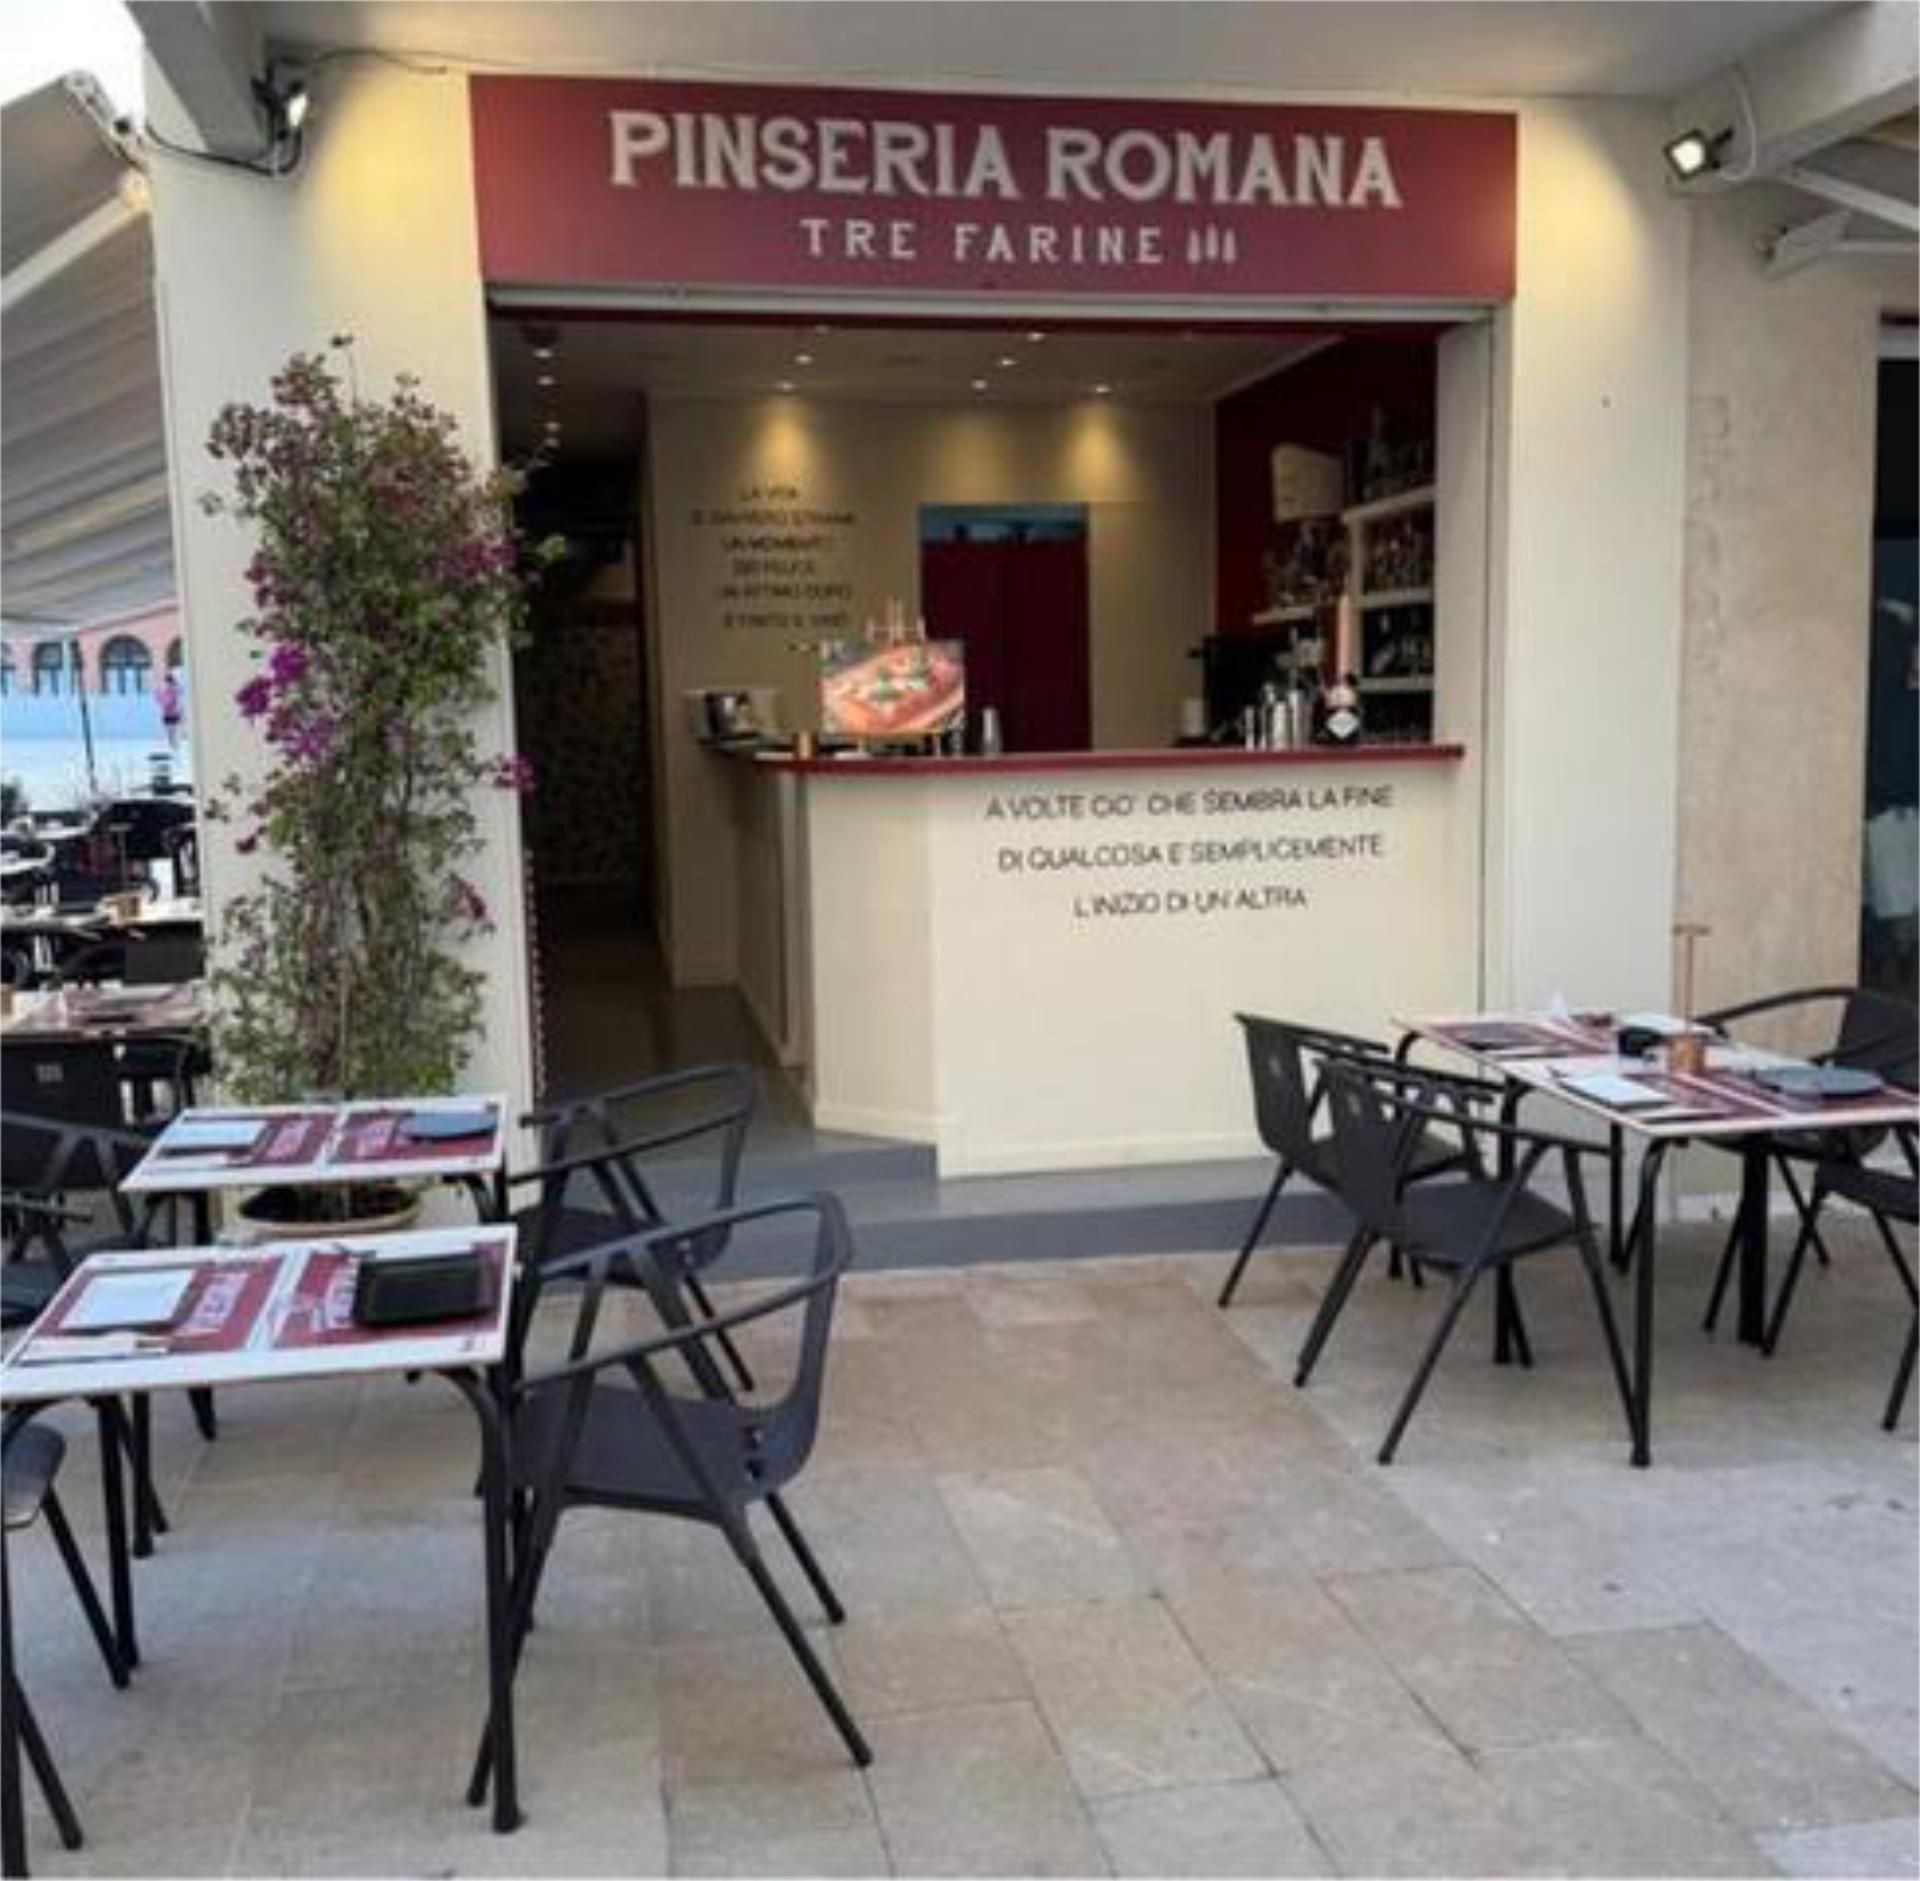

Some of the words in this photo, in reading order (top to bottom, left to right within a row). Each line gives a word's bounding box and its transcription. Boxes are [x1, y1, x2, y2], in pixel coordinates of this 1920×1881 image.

[608, 110, 1022, 199] PINSERIA
[1045, 125, 1403, 209] ROMANA
[800, 217, 917, 260] TRE
[953, 222, 1163, 265] FARINE
[985, 797, 1004, 819] A
[1006, 795, 1086, 819] VOLTE
[1146, 791, 1196, 816] CHE
[1202, 786, 1303, 815] SEMBRA
[1307, 786, 1337, 810] LA
[1341, 784, 1393, 808] FINE
[998, 849, 1024, 872] DI
[1027, 844, 1162, 870] QUALCOSA
[1191, 833, 1384, 864] SEMPLICEMENTE
[1166, 889, 1189, 913] DI
